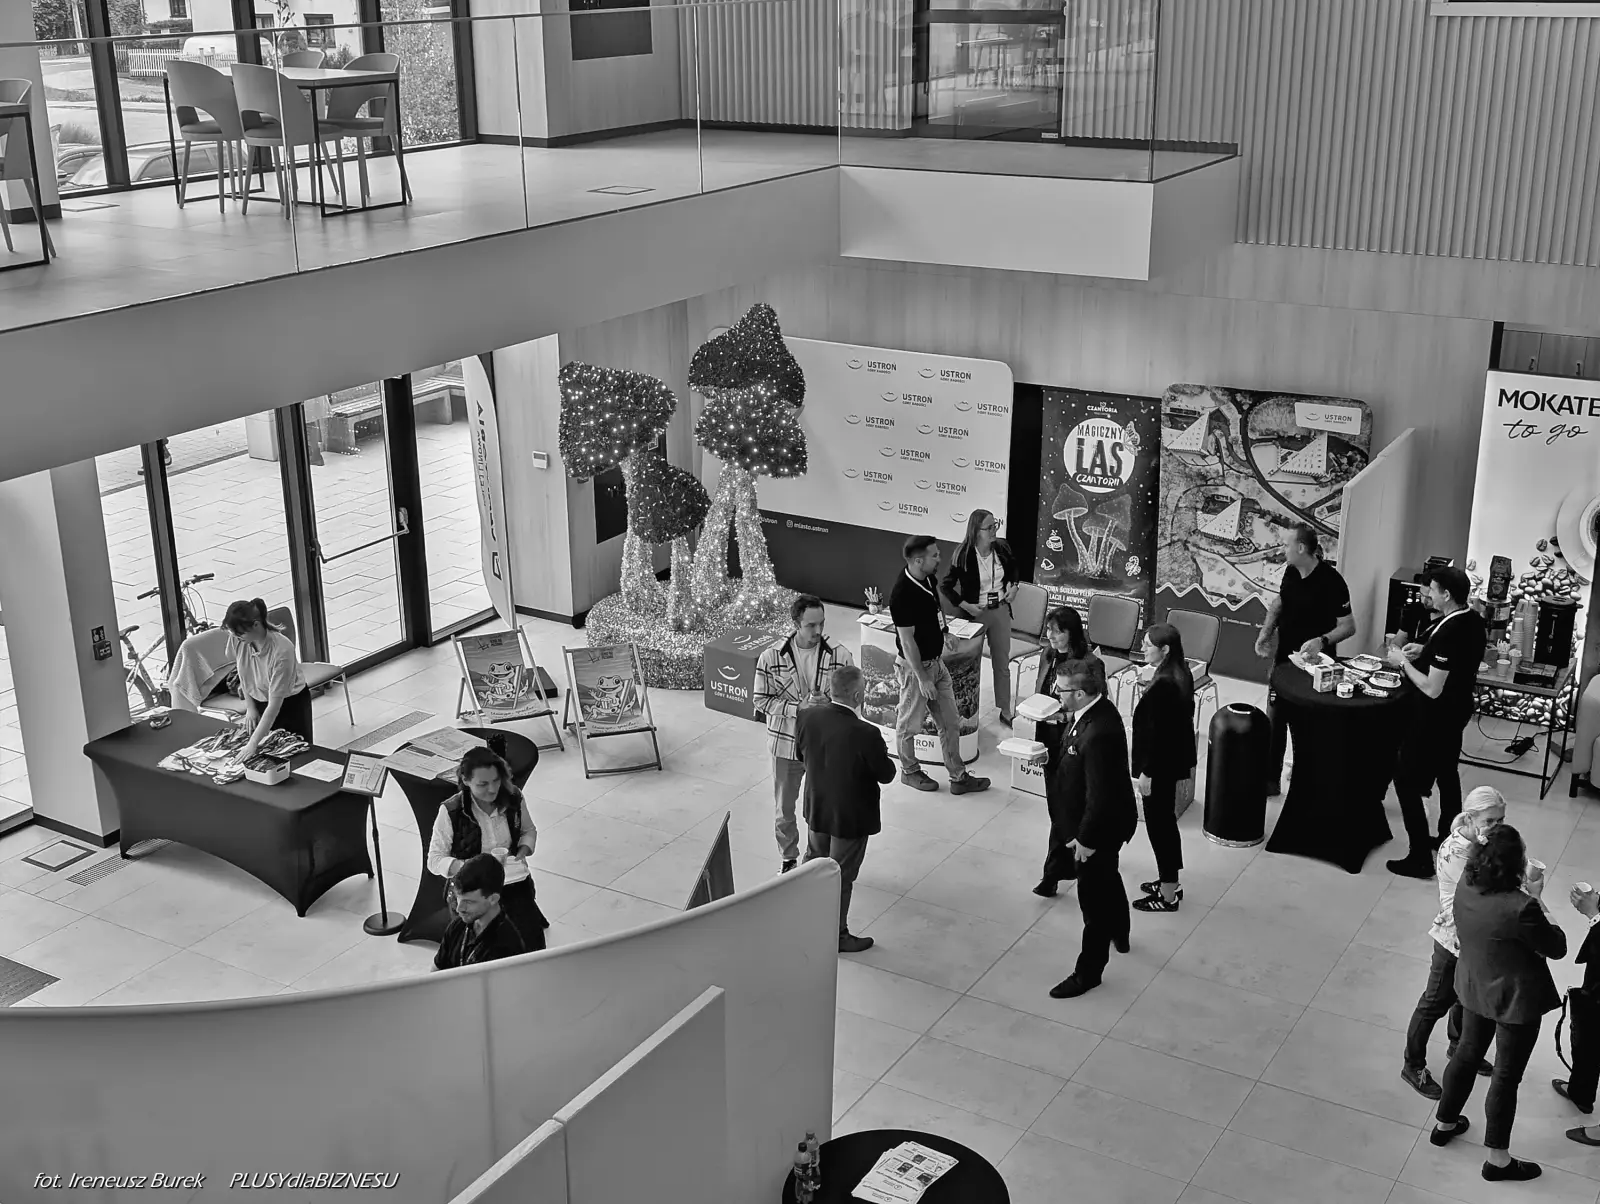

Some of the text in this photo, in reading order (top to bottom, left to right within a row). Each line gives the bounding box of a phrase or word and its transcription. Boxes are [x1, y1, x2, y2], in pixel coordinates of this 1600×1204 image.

[1087, 405, 1118, 413] CZANTORIA
[1497, 388, 1600, 417] MOKATE
[1077, 424, 1124, 440] MAGICZNY
[1502, 419, 1588, 445] to go
[1075, 437, 1124, 477] LAS
[1076, 473, 1120, 486] CZANTORII
[710, 680, 748, 698] USTROŃ
[1020, 765, 1031, 775] by
